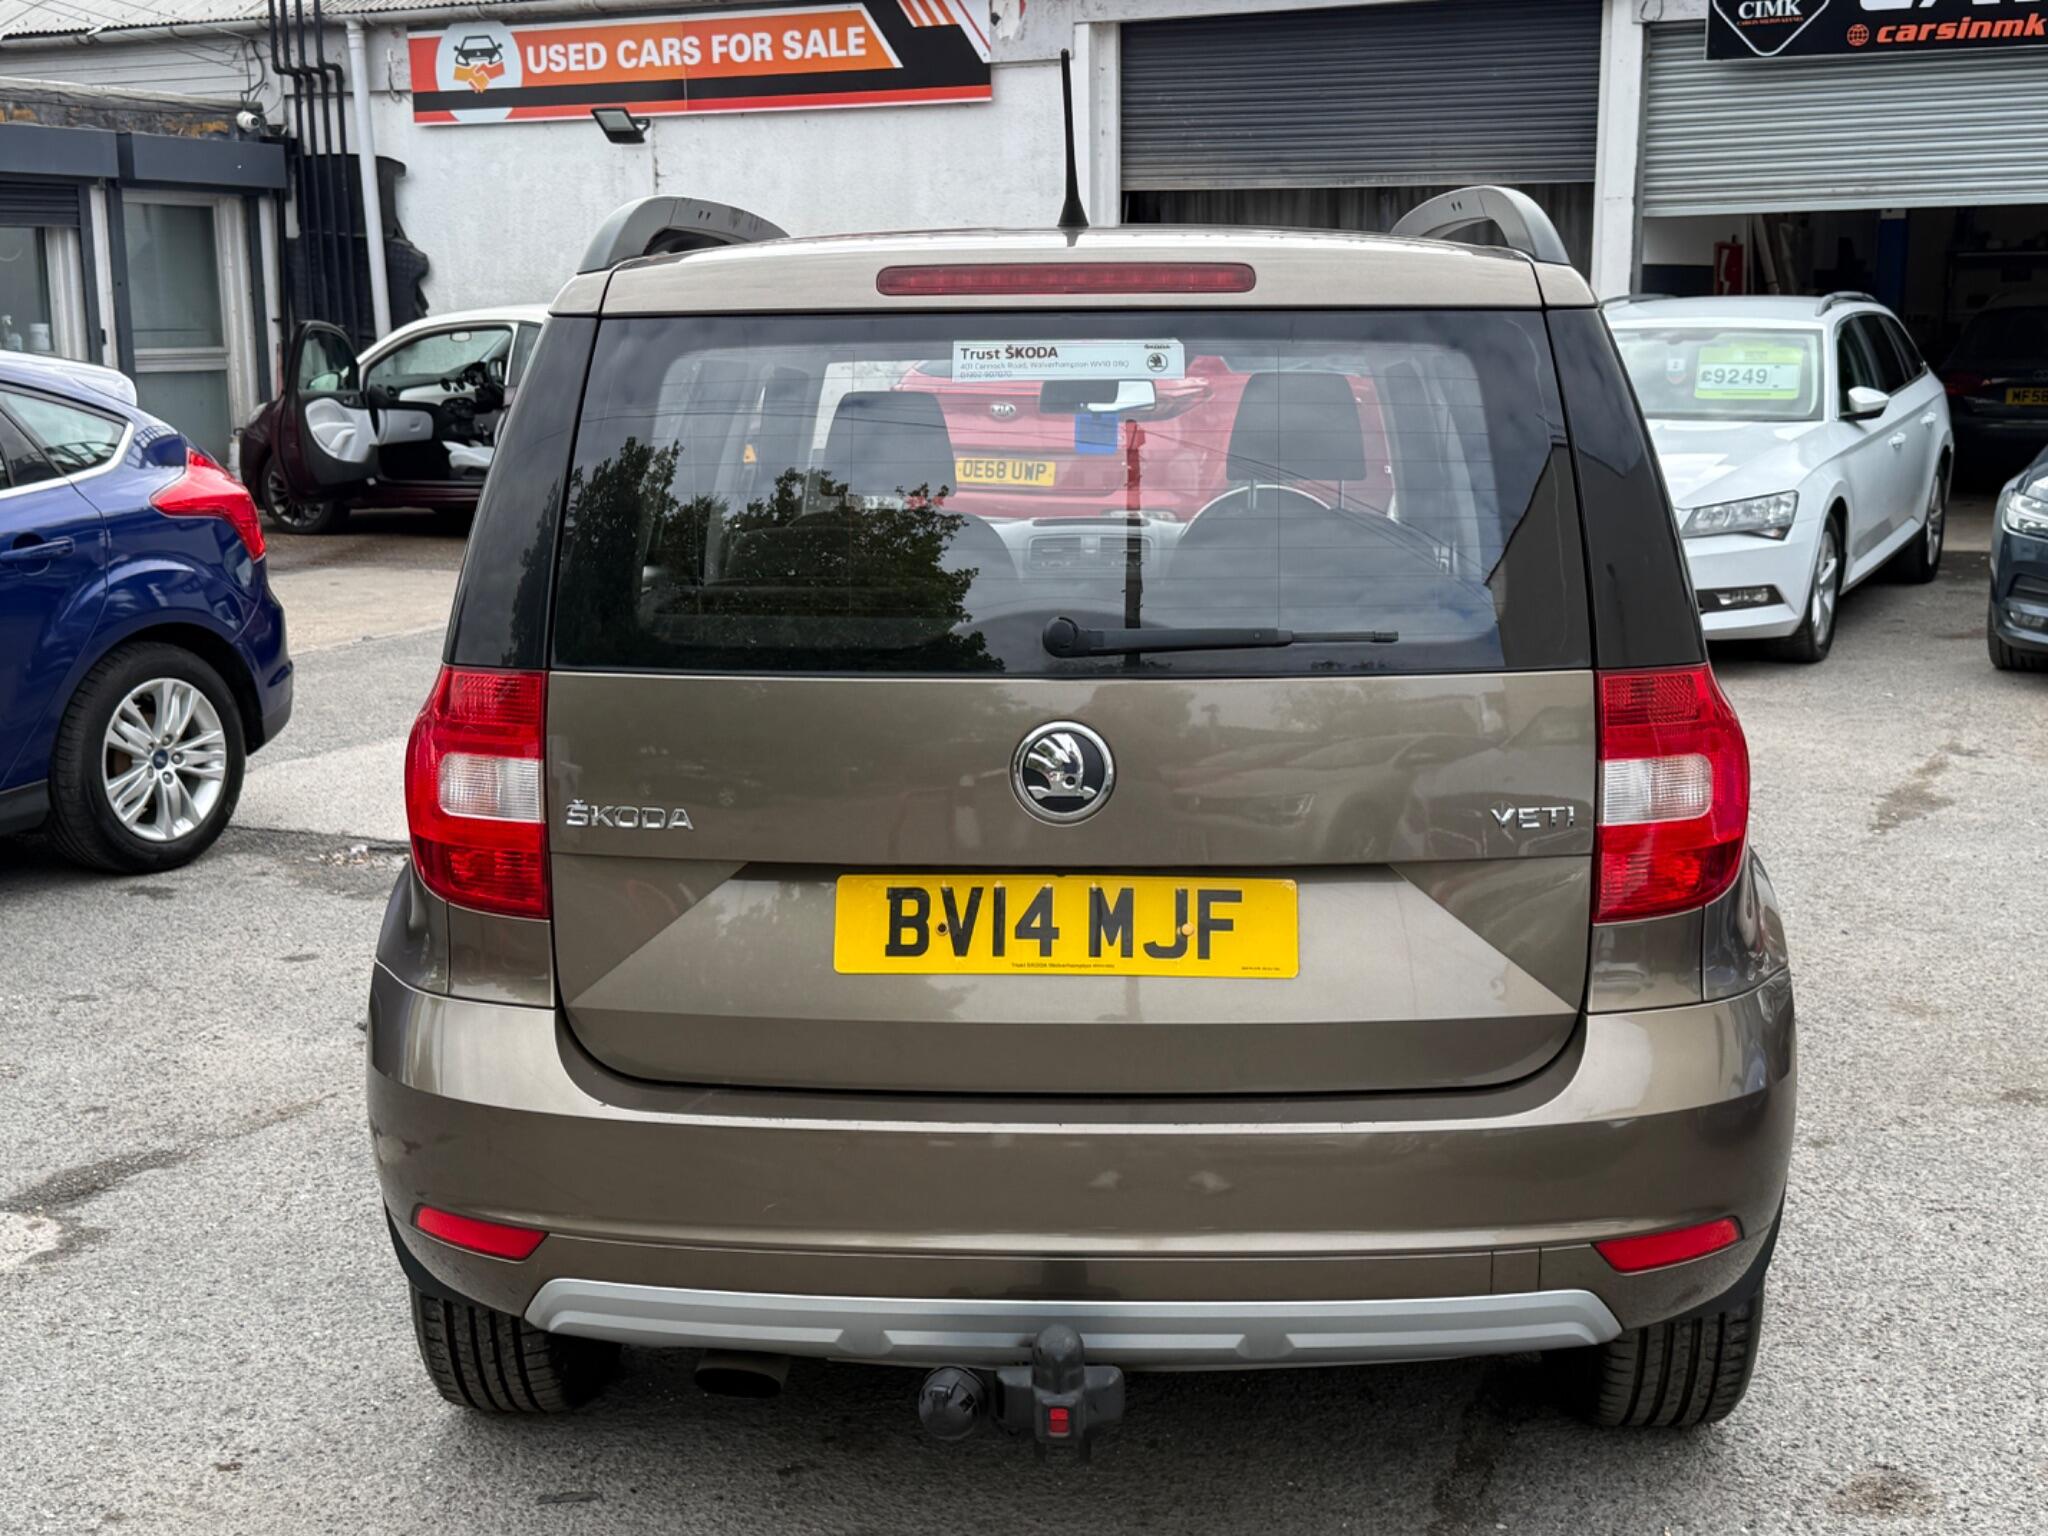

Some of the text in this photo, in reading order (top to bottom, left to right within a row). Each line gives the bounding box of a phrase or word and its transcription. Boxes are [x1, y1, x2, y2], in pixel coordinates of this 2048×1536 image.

[1738, 0, 1802, 19] CIMK
[1876, 13, 2048, 43] carsinmk
[526, 26, 866, 74] USED CARS FOR SALE
[960, 344, 1058, 361] Trust ŠKODA
[1701, 368, 1768, 385] £9249
[962, 459, 1048, 481] OE68 UWP
[566, 799, 694, 830] ŠKODA
[1490, 806, 1575, 828] YETI
[885, 886, 1243, 960] BV14 MJF
